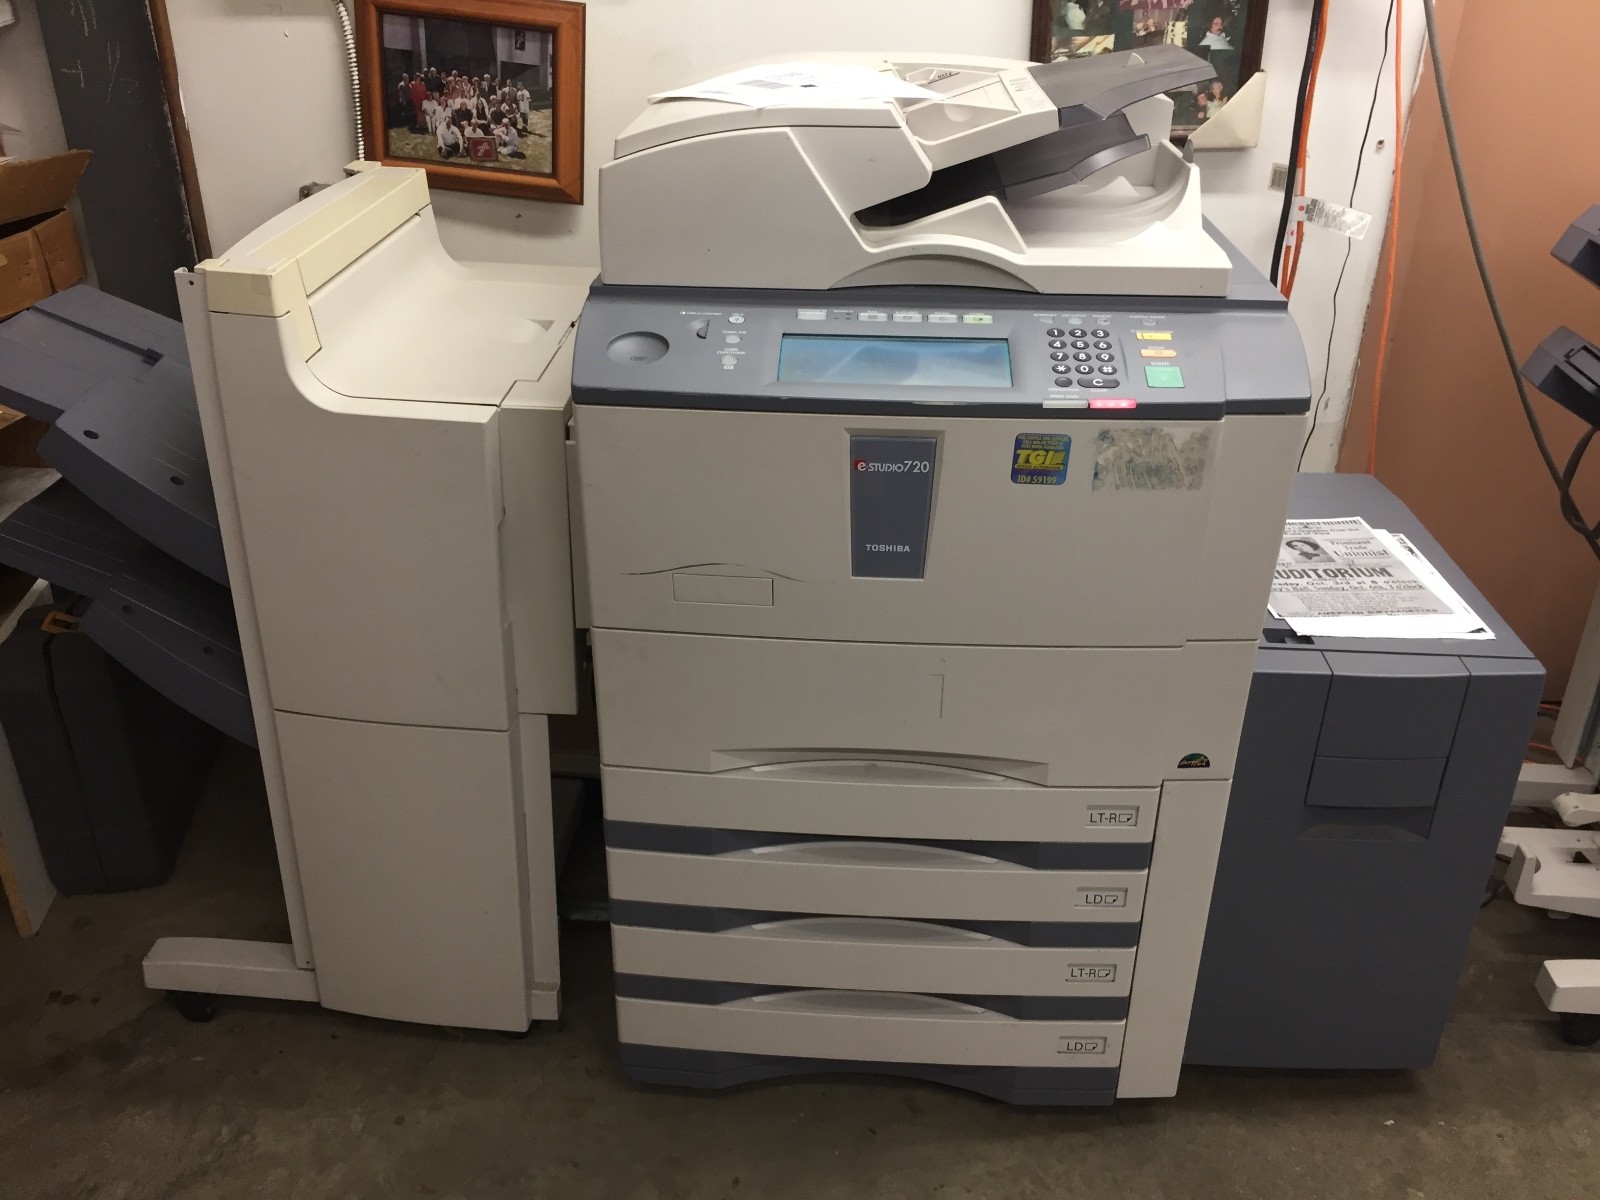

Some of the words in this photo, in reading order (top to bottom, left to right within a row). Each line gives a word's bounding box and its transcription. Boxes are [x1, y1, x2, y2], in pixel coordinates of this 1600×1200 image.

[1099, 341, 1107, 349] 6
[1056, 352, 1064, 360] 7
[1092, 378, 1104, 386] C
[1017, 475, 1031, 483] ID#
[1032, 475, 1057, 484] 59199
[865, 544, 911, 553] TOSHIBA
[1333, 549, 1389, 557] Unionist
[1089, 813, 1117, 824] LT-R
[1085, 894, 1103, 905] LD
[1070, 968, 1096, 979] LT-R
[1066, 1041, 1083, 1052] LD
